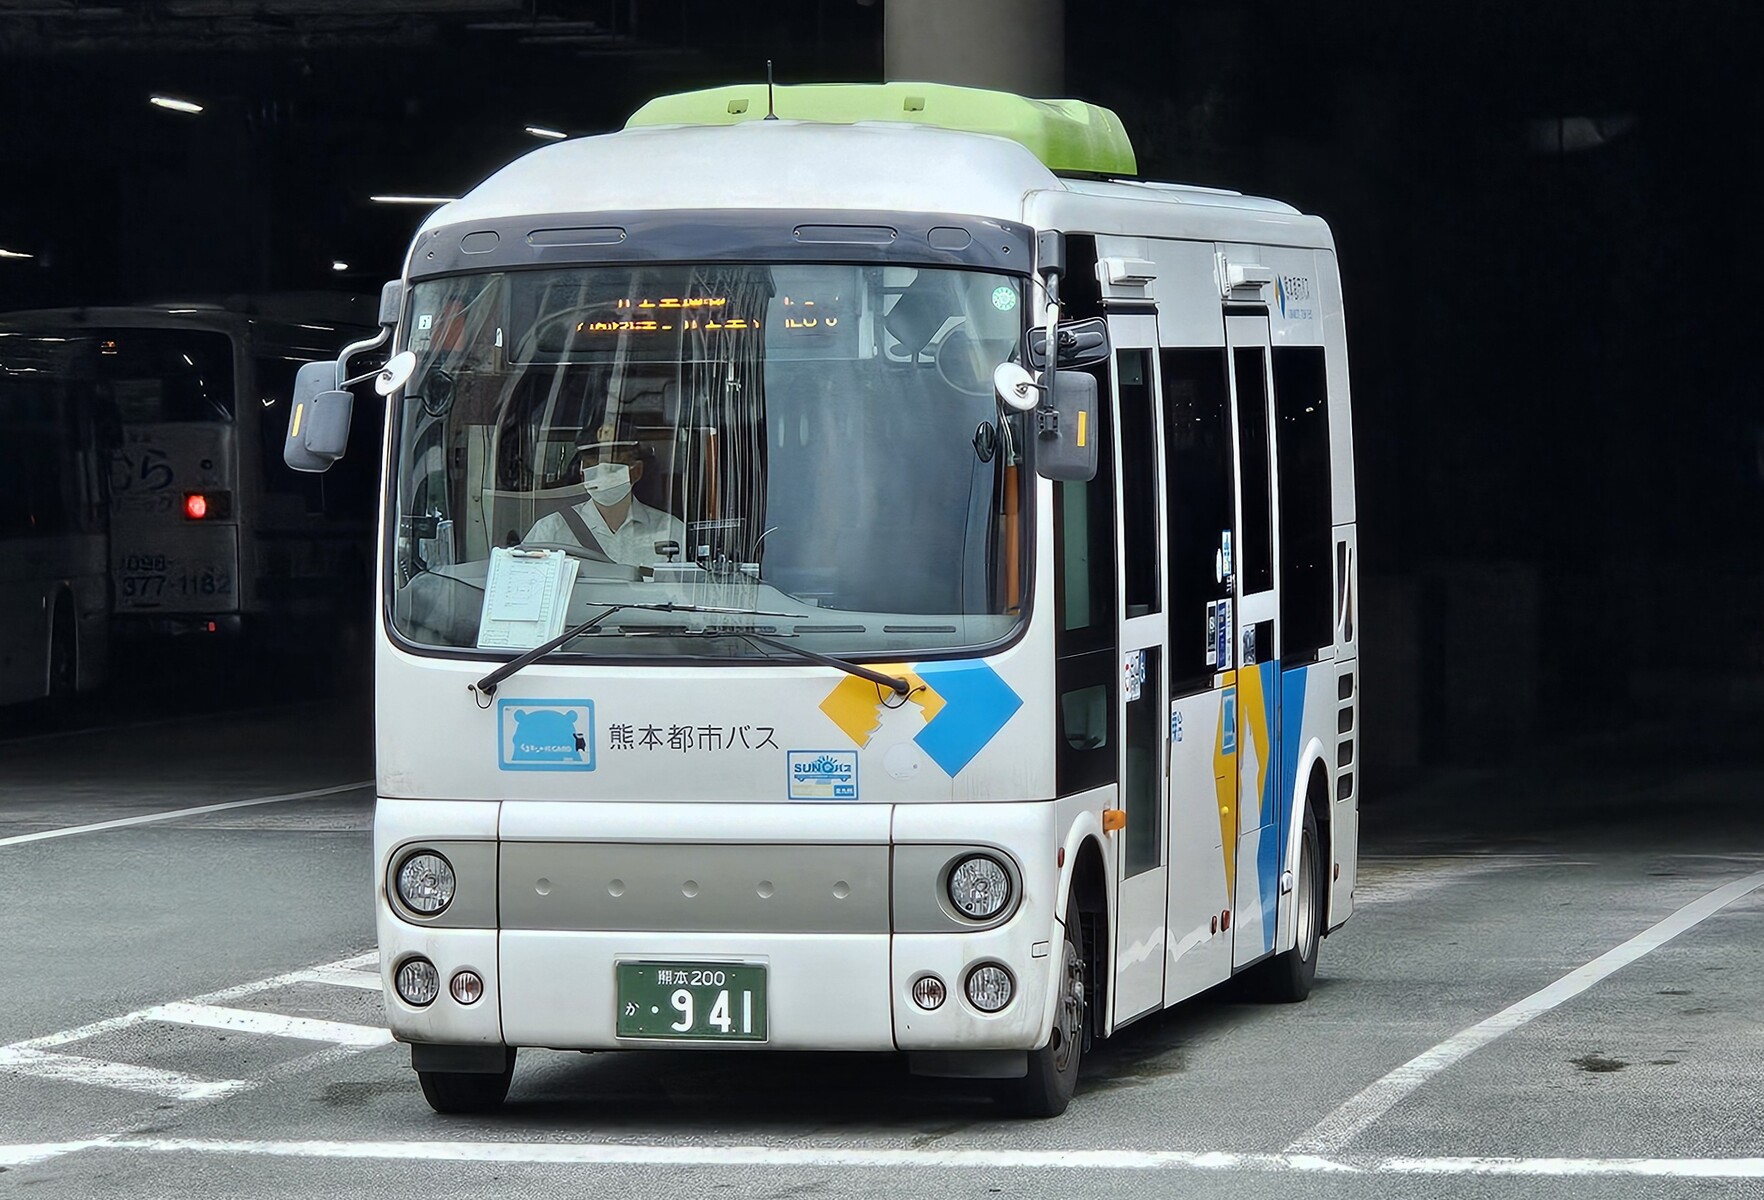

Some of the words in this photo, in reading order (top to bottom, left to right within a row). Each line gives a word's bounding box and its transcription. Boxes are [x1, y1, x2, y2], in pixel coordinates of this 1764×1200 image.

[123, 575, 232, 597] 377-1182
[608, 722, 780, 753] 熊本都市バス
